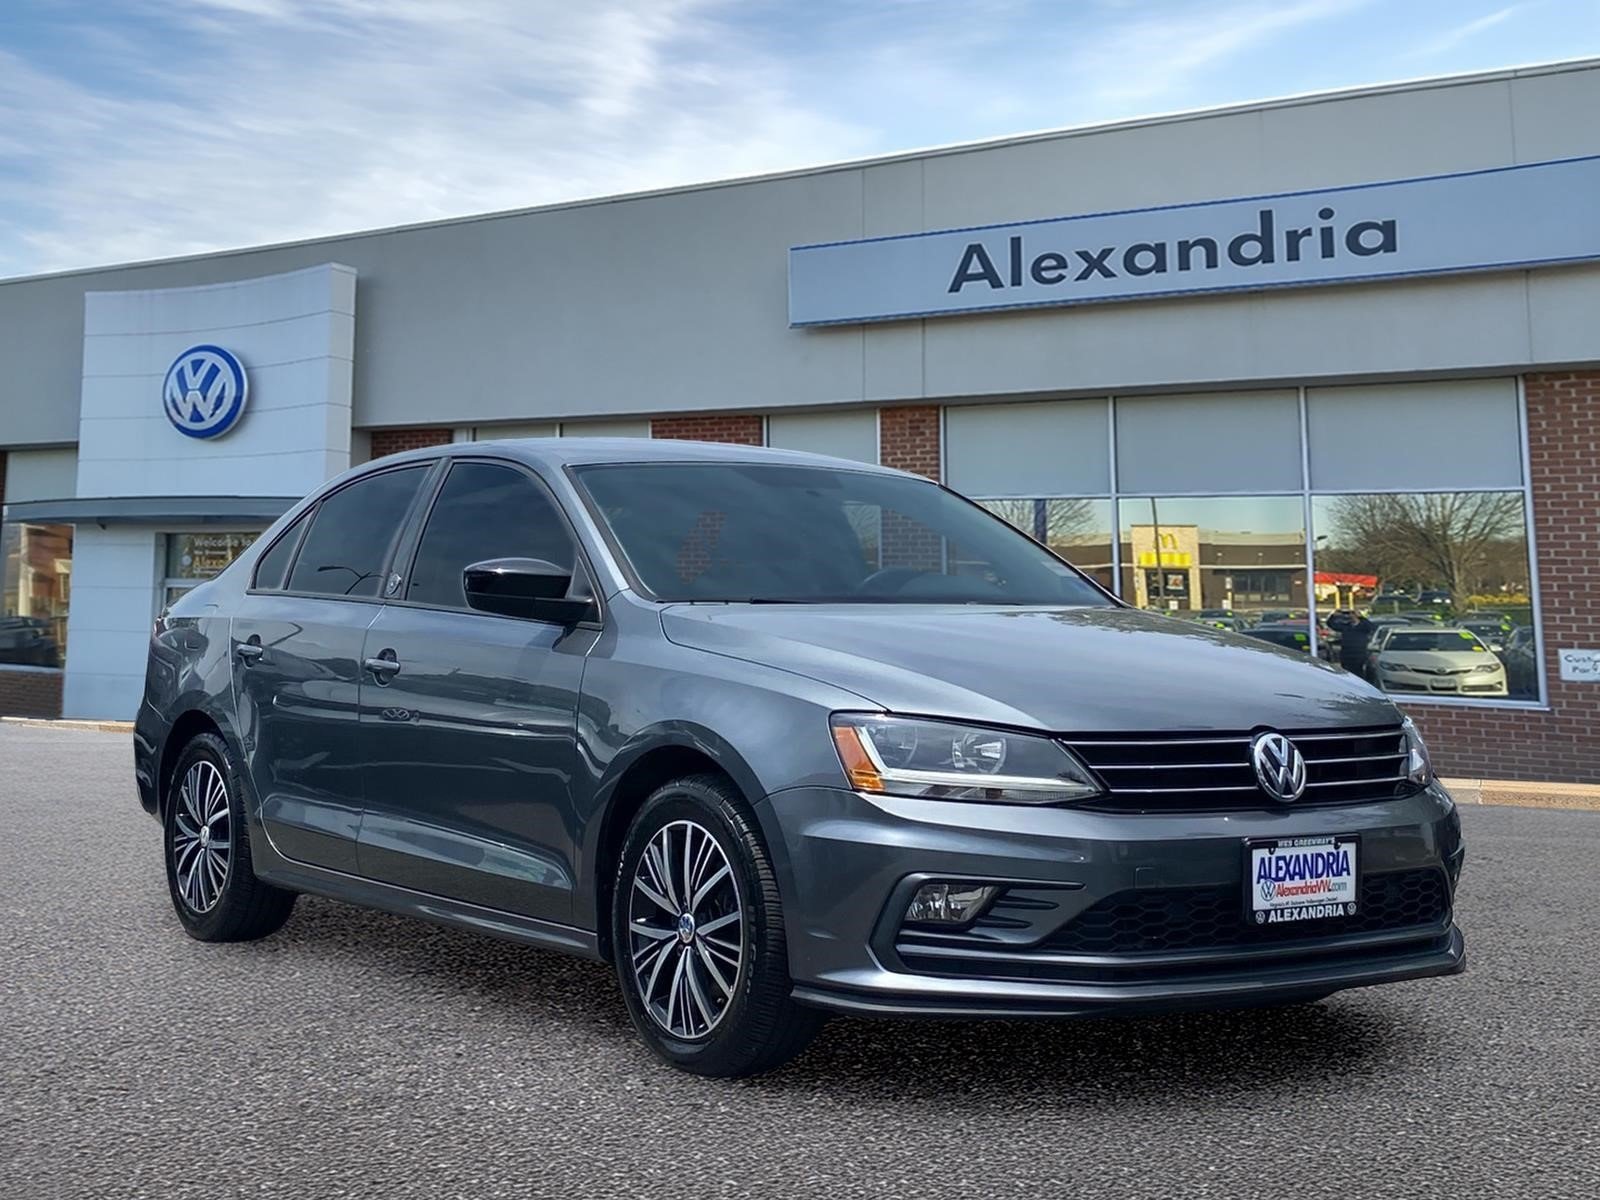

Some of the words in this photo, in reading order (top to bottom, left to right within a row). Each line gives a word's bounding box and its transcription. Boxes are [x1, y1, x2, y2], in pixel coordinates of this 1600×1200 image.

[947, 207, 1398, 293] Alexandria
[1256, 850, 1351, 884] ALEXANDRIA
[1268, 903, 1345, 923] ALEXANDRIA
